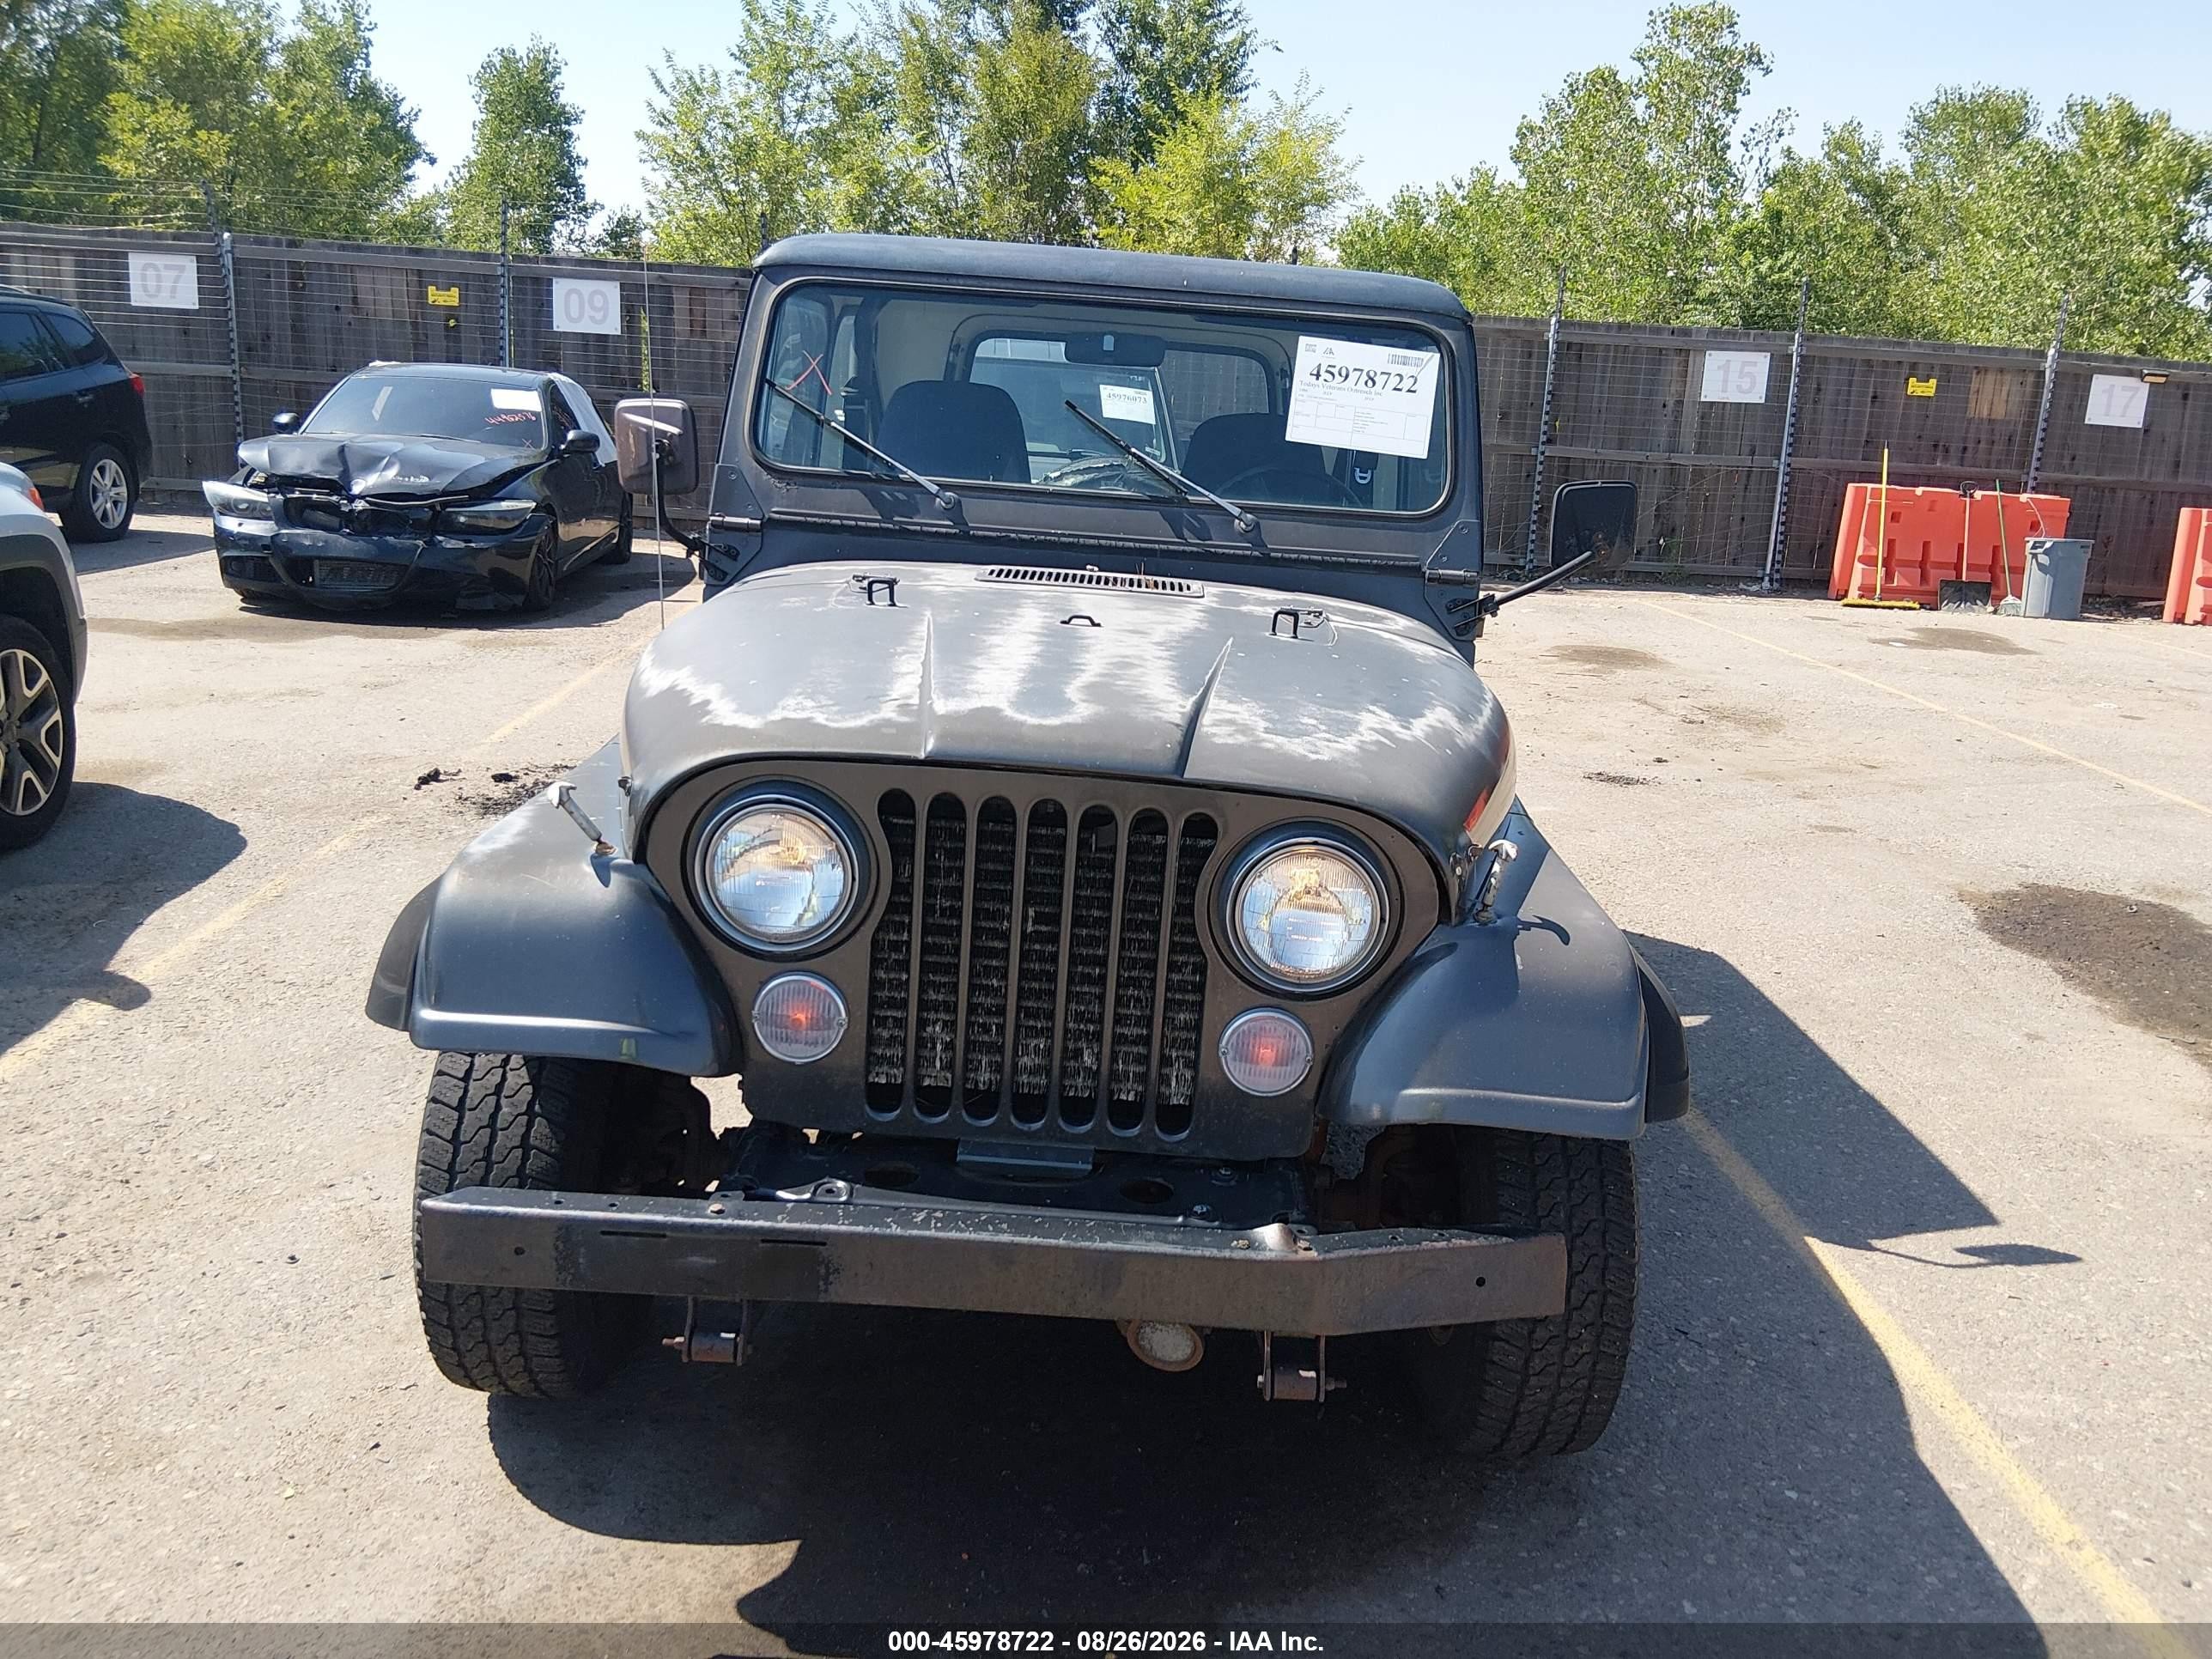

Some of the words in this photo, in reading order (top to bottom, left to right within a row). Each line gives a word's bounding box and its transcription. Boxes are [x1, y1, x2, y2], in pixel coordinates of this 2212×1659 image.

[141, 262, 185, 299] 07
[564, 288, 609, 325] 09
[1310, 362, 1419, 394] 45978722
[1322, 383, 1346, 392] Veterans
[1346, 386, 1373, 395] Outreach
[1717, 359, 1758, 394] 15
[2102, 384, 2140, 418] 17
